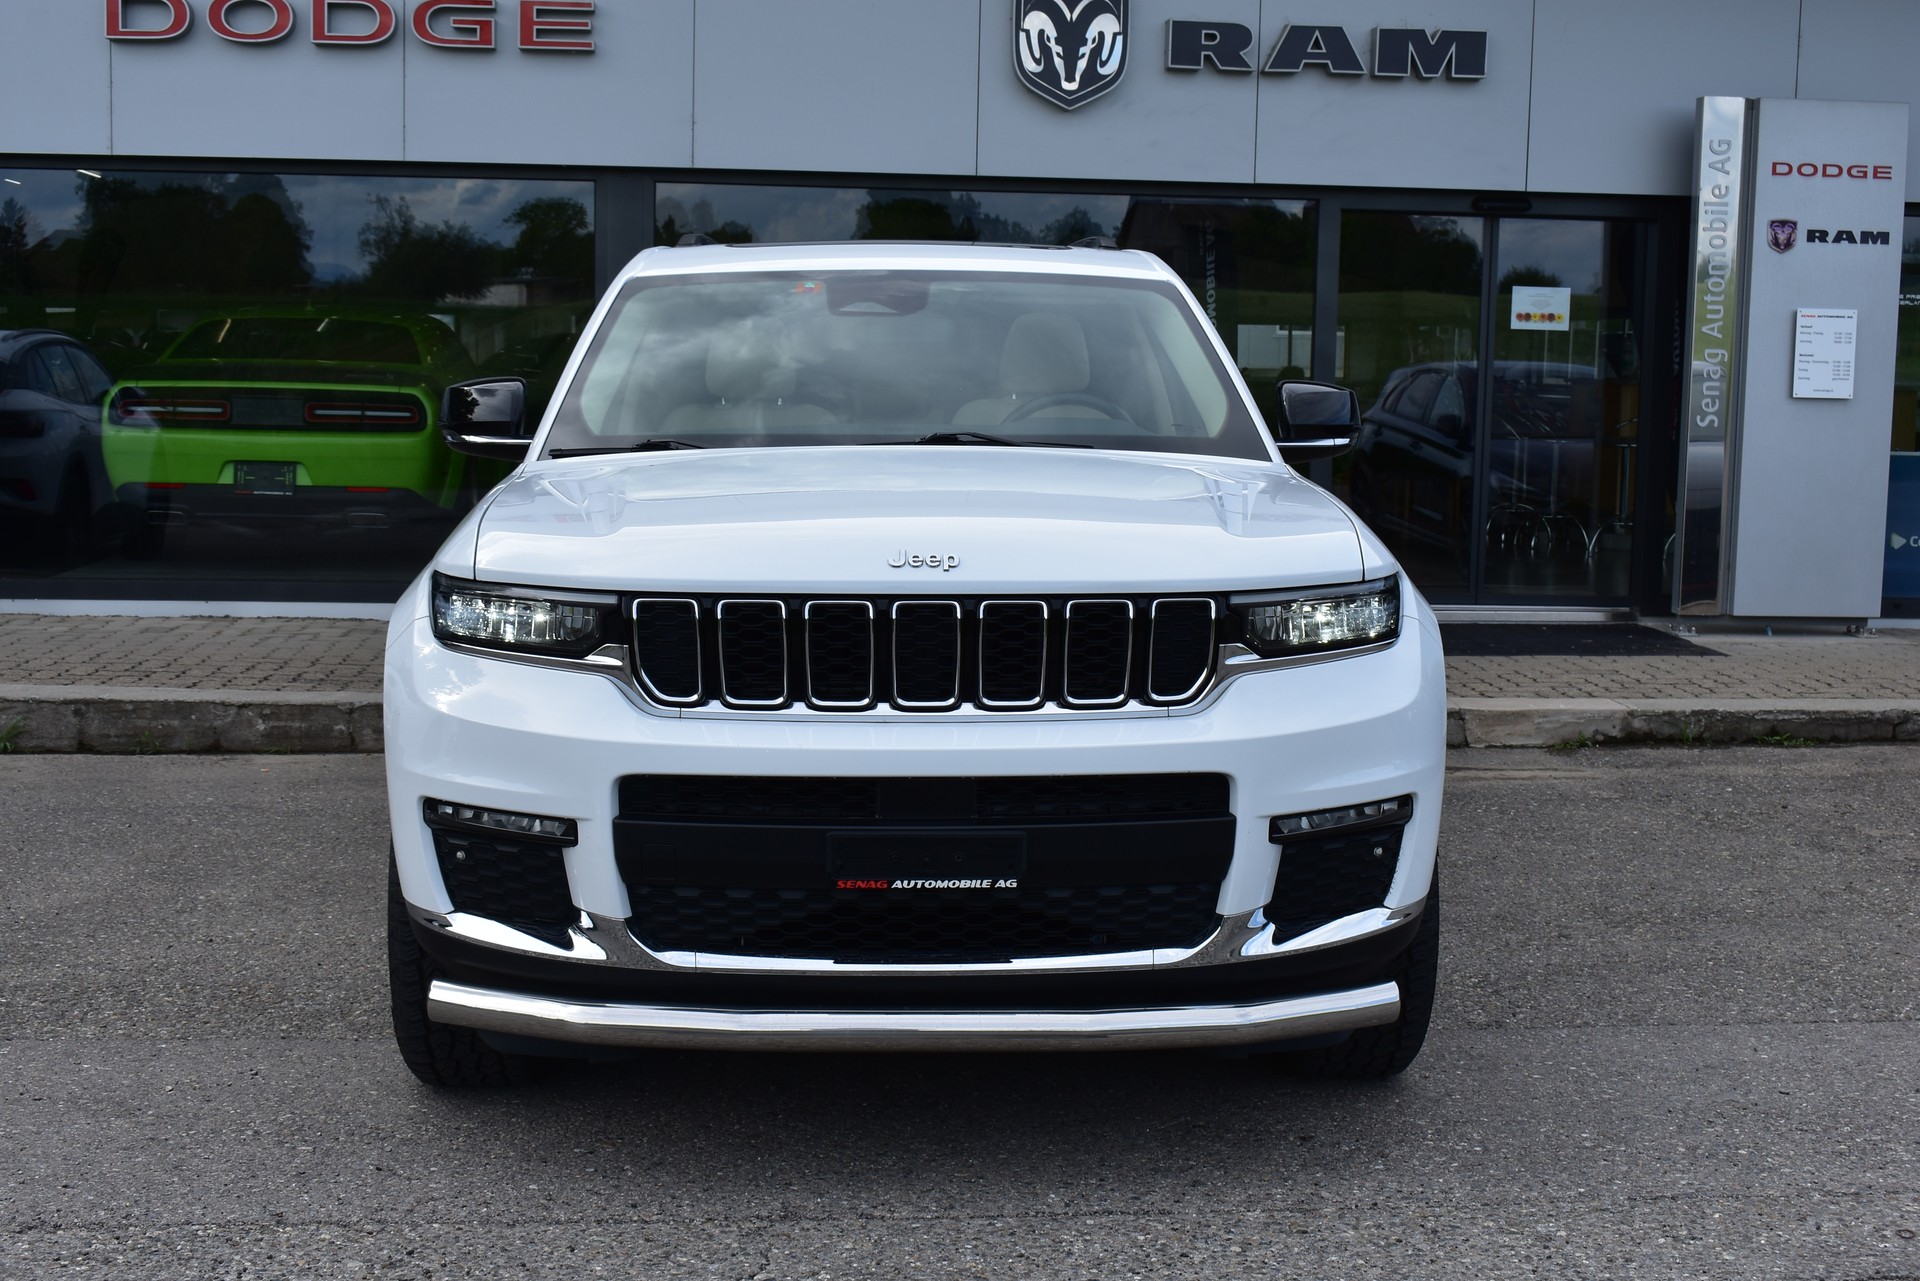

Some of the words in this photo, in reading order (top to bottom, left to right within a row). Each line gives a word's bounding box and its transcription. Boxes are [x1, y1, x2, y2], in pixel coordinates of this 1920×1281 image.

[105, 0, 595, 51] DODGE
[1165, 18, 1488, 79] RAM
[1708, 139, 1732, 175] AG
[1771, 162, 1893, 180] DODGE
[1806, 229, 1890, 245] RAM
[1701, 184, 1730, 339] Automobile
[1697, 348, 1728, 428] Senag
[887, 547, 960, 572] Jeep
[836, 879, 888, 889] SENAG
[891, 879, 993, 889] AUTOMOBILE
[994, 879, 1018, 888] AG
